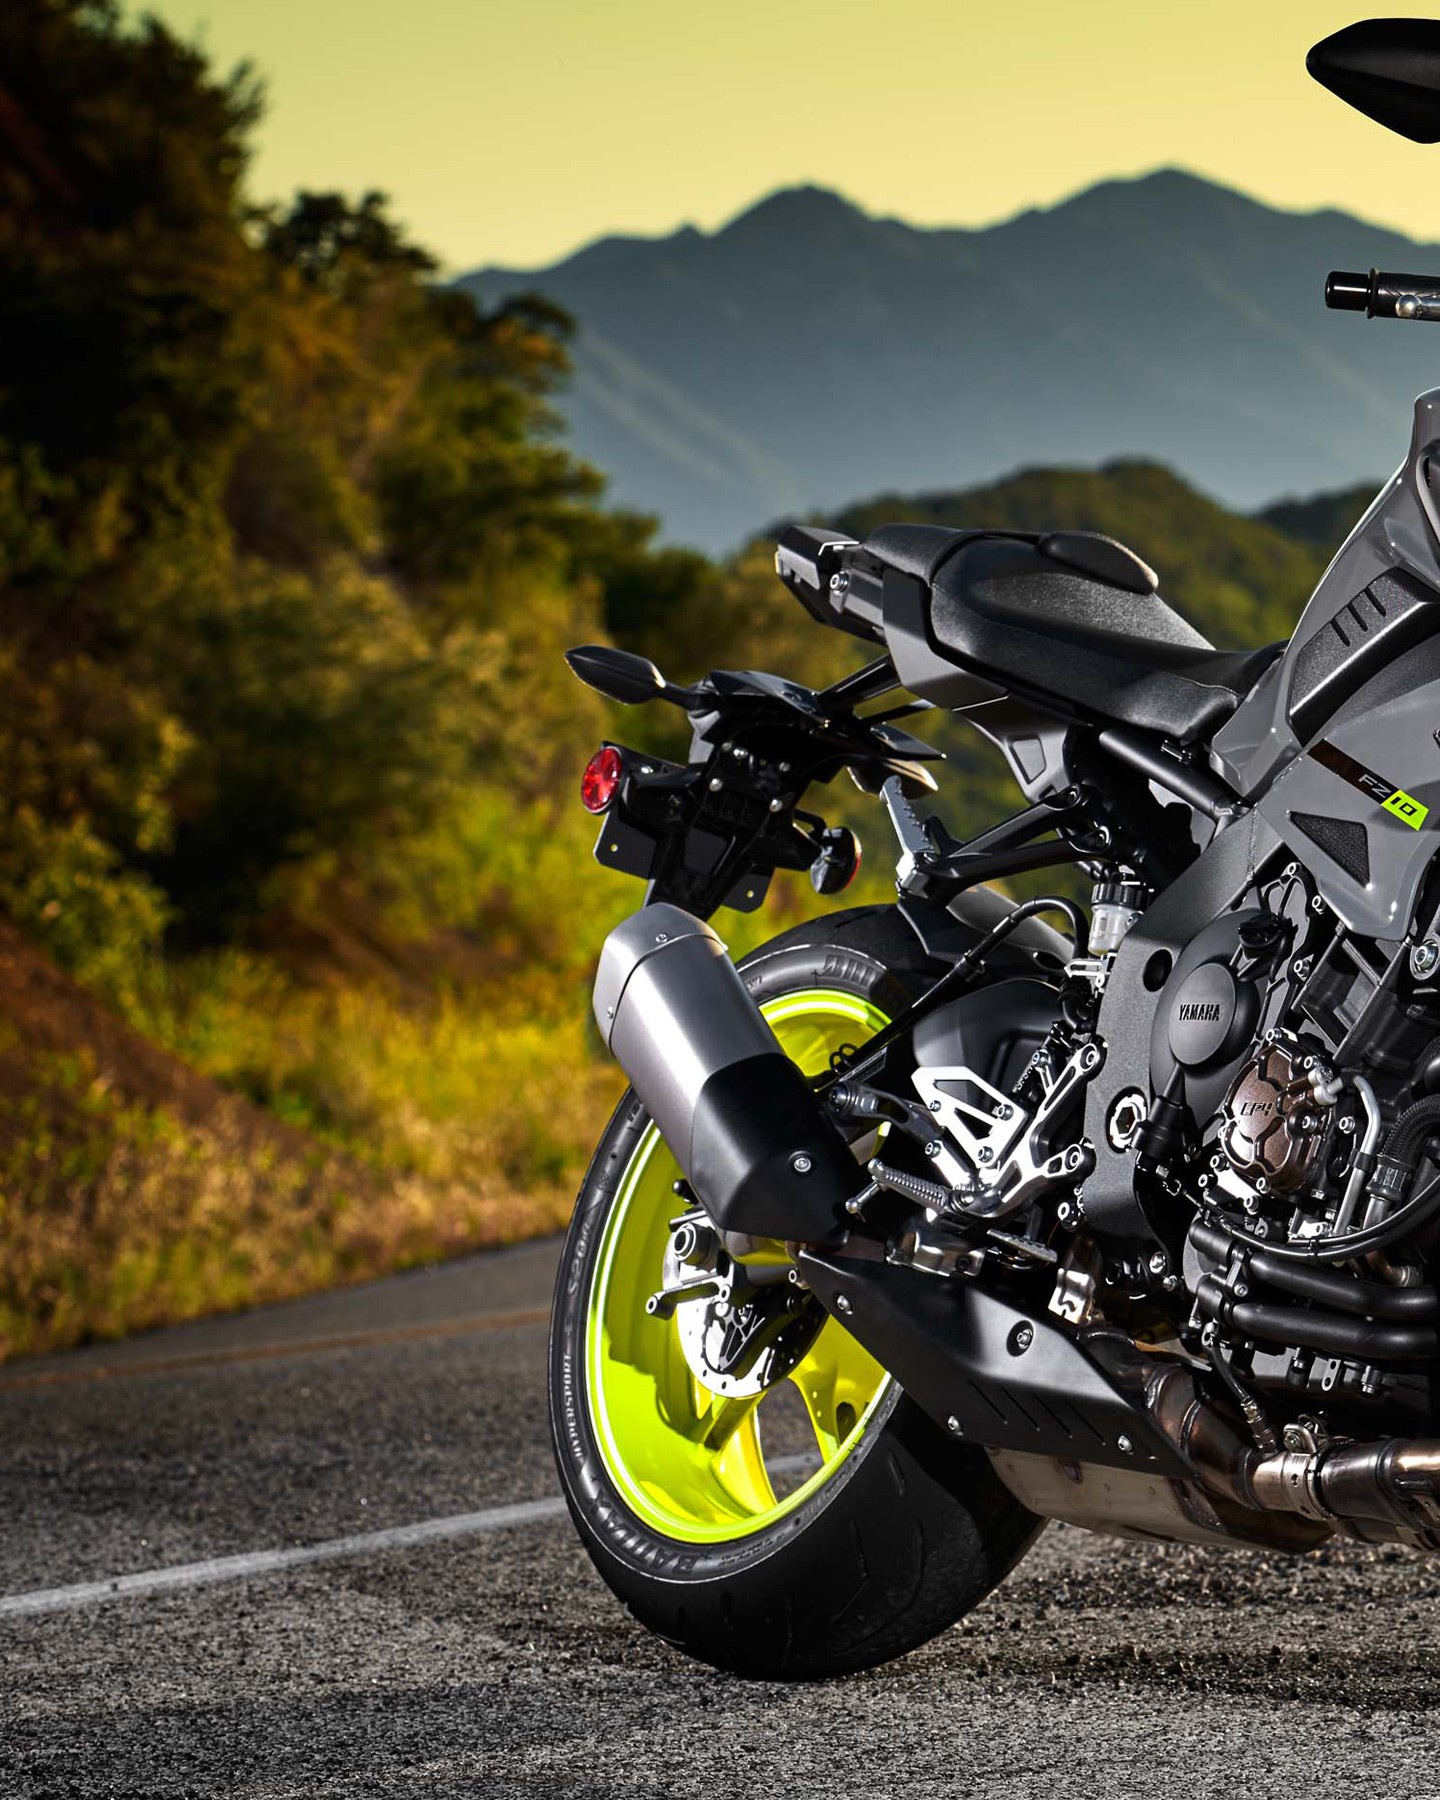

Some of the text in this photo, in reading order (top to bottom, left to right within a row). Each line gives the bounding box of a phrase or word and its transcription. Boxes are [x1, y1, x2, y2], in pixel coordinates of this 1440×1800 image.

[1179, 1003, 1220, 1021] YAMAHA
[1240, 1102, 1273, 1116] CP4
[563, 1353, 583, 1458] HYPERSPORT
